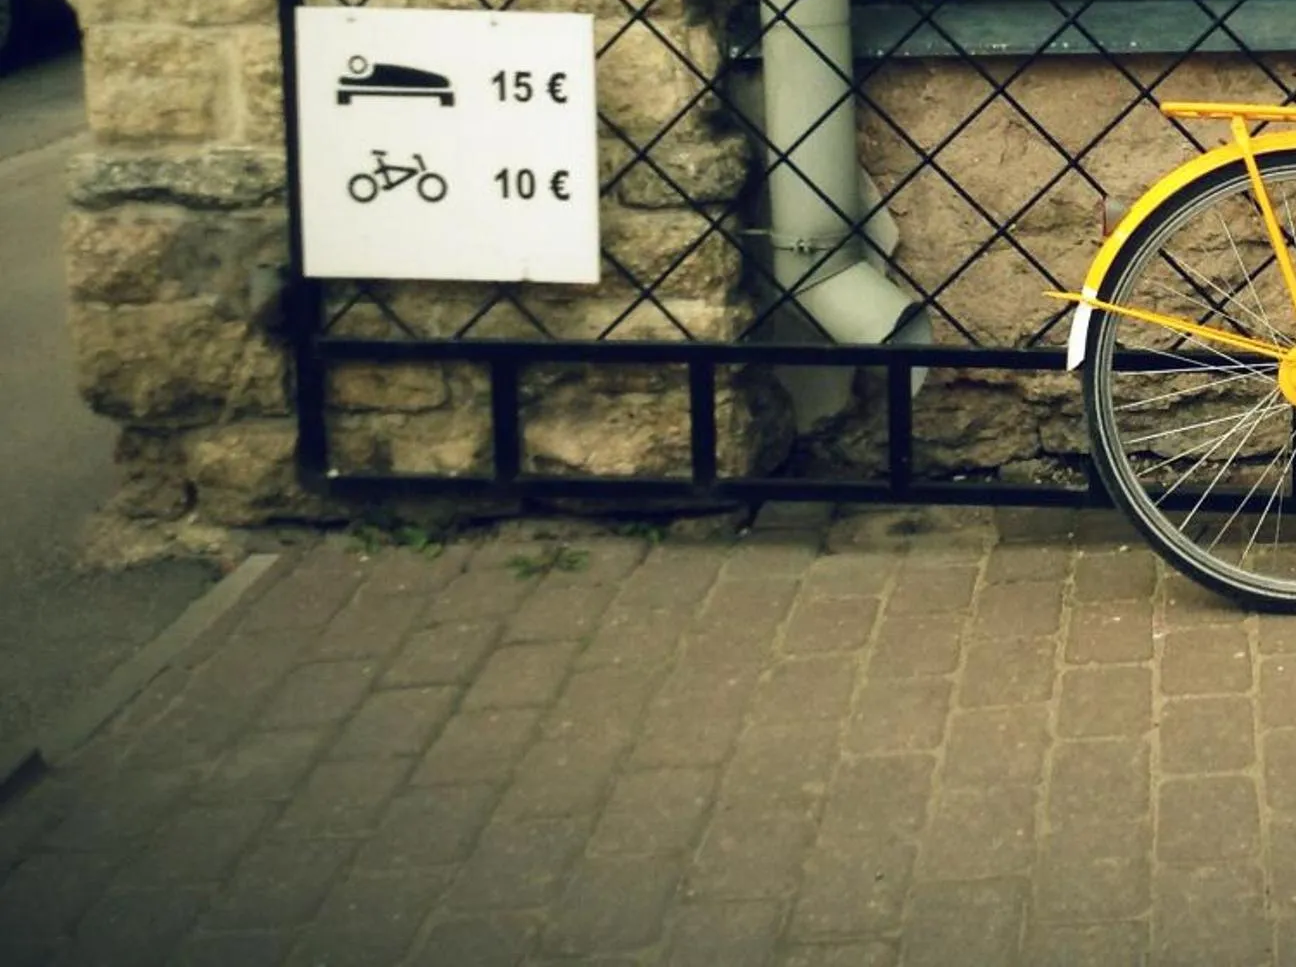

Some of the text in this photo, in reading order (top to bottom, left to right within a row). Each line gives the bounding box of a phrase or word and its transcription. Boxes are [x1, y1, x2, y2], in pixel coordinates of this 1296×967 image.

[491, 70, 568, 104] 15 €
[494, 168, 571, 201] 10 €
